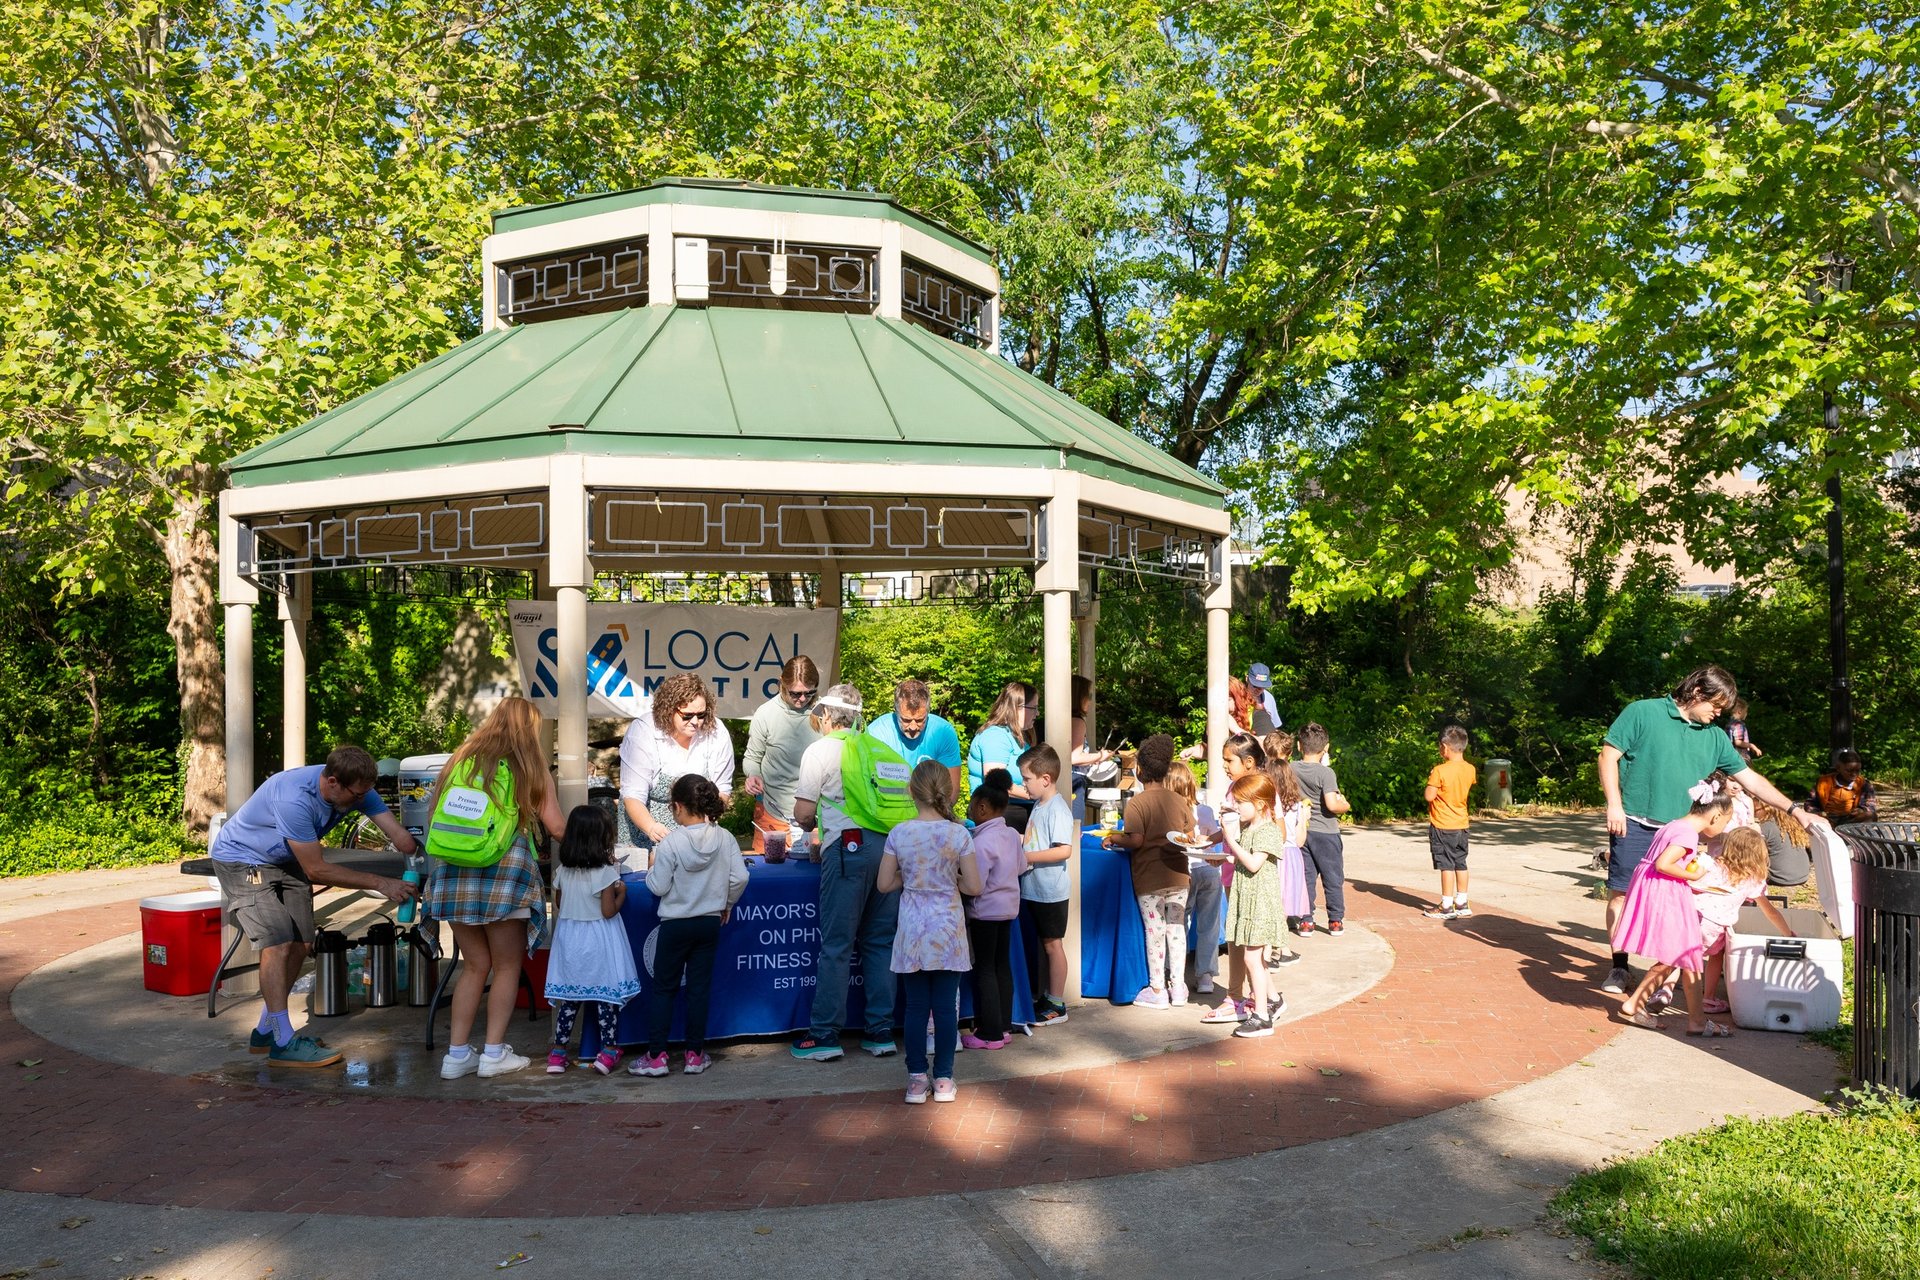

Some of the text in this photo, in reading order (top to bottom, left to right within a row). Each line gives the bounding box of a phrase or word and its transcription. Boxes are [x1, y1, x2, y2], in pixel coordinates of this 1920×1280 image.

[447, 801, 483, 813] Kindergarten
[736, 903, 816, 921] MAYOR'S
[759, 928, 786, 945] ON
[737, 951, 812, 970] FITNESS
[774, 977, 797, 989] EST
